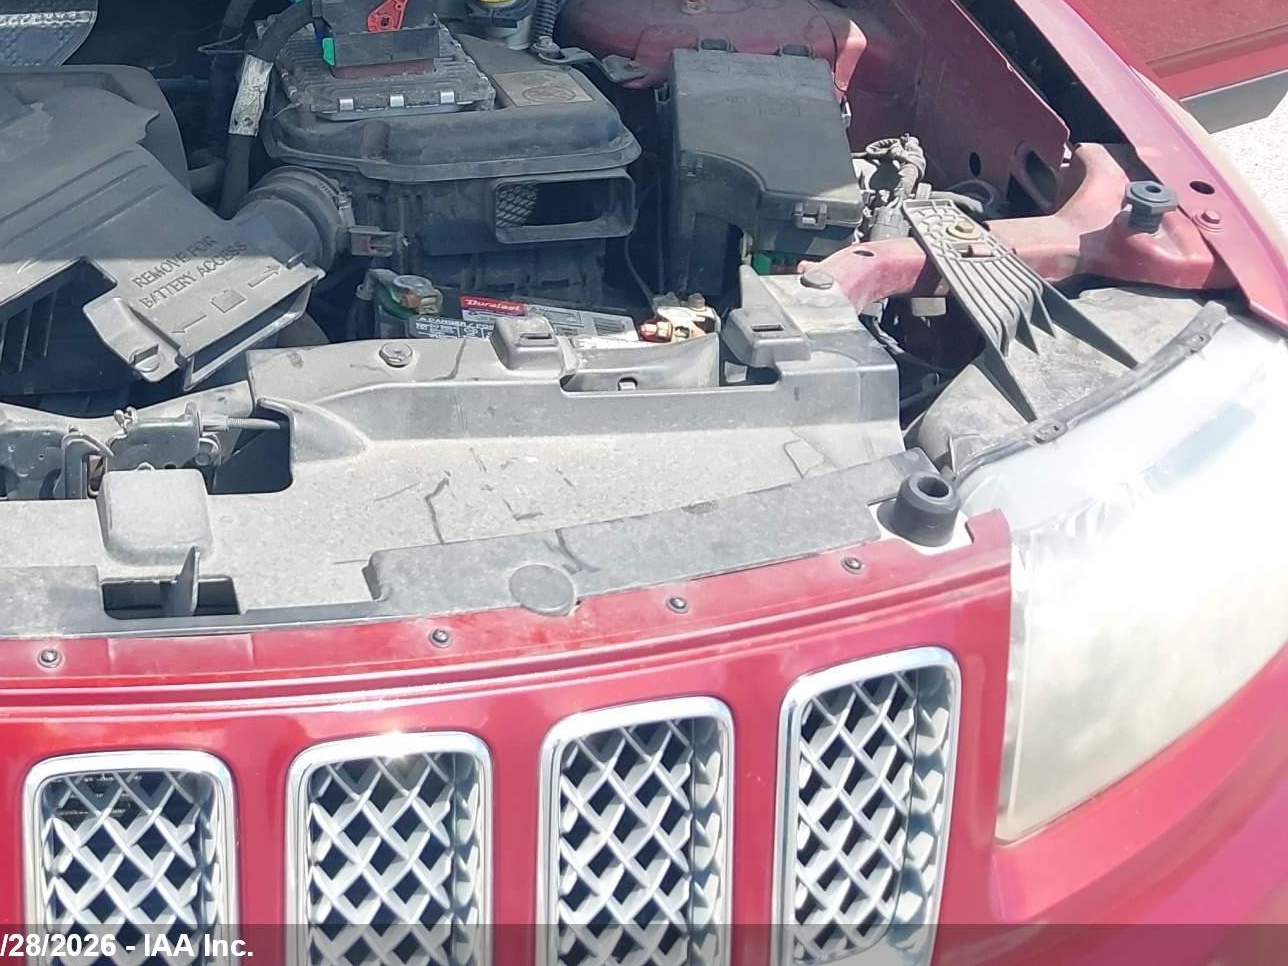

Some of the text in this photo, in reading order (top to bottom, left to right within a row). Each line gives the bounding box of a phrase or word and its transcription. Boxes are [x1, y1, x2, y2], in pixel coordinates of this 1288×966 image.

[132, 234, 219, 288] REMOVE FOR
[138, 240, 248, 309] BATTERY ACCESS
[465, 298, 522, 313] Duralast
